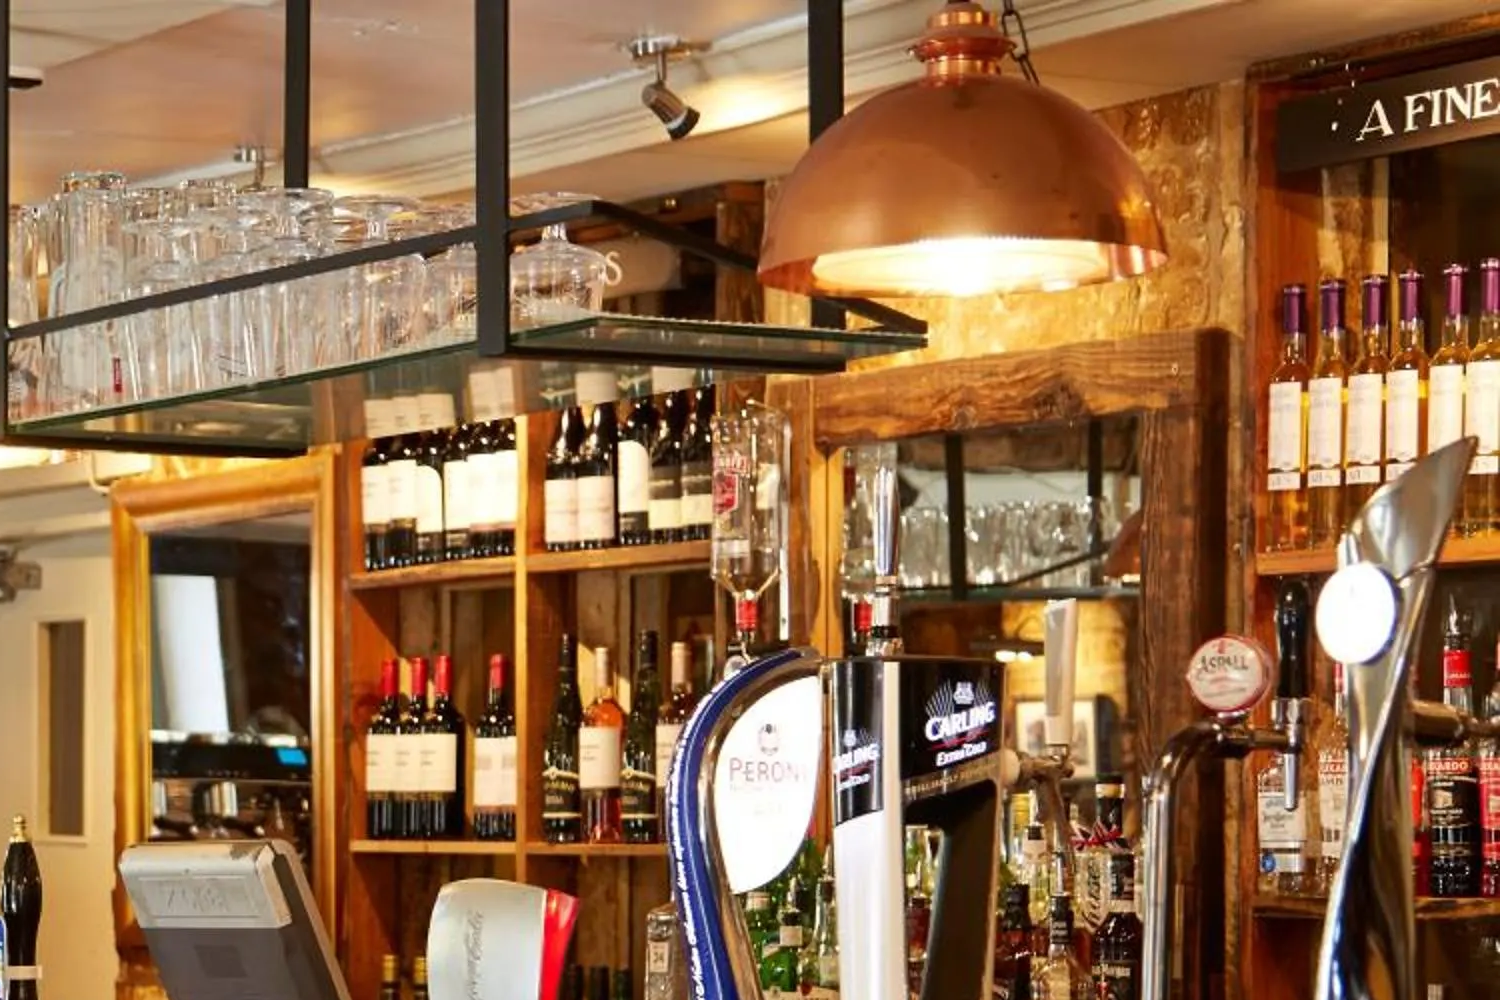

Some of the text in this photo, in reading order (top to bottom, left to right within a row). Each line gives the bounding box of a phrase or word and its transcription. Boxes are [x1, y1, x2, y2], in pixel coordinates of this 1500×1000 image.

[1356, 78, 1500, 141] A FINE
[925, 701, 995, 741] CARLING
[729, 757, 808, 783] PERONI
